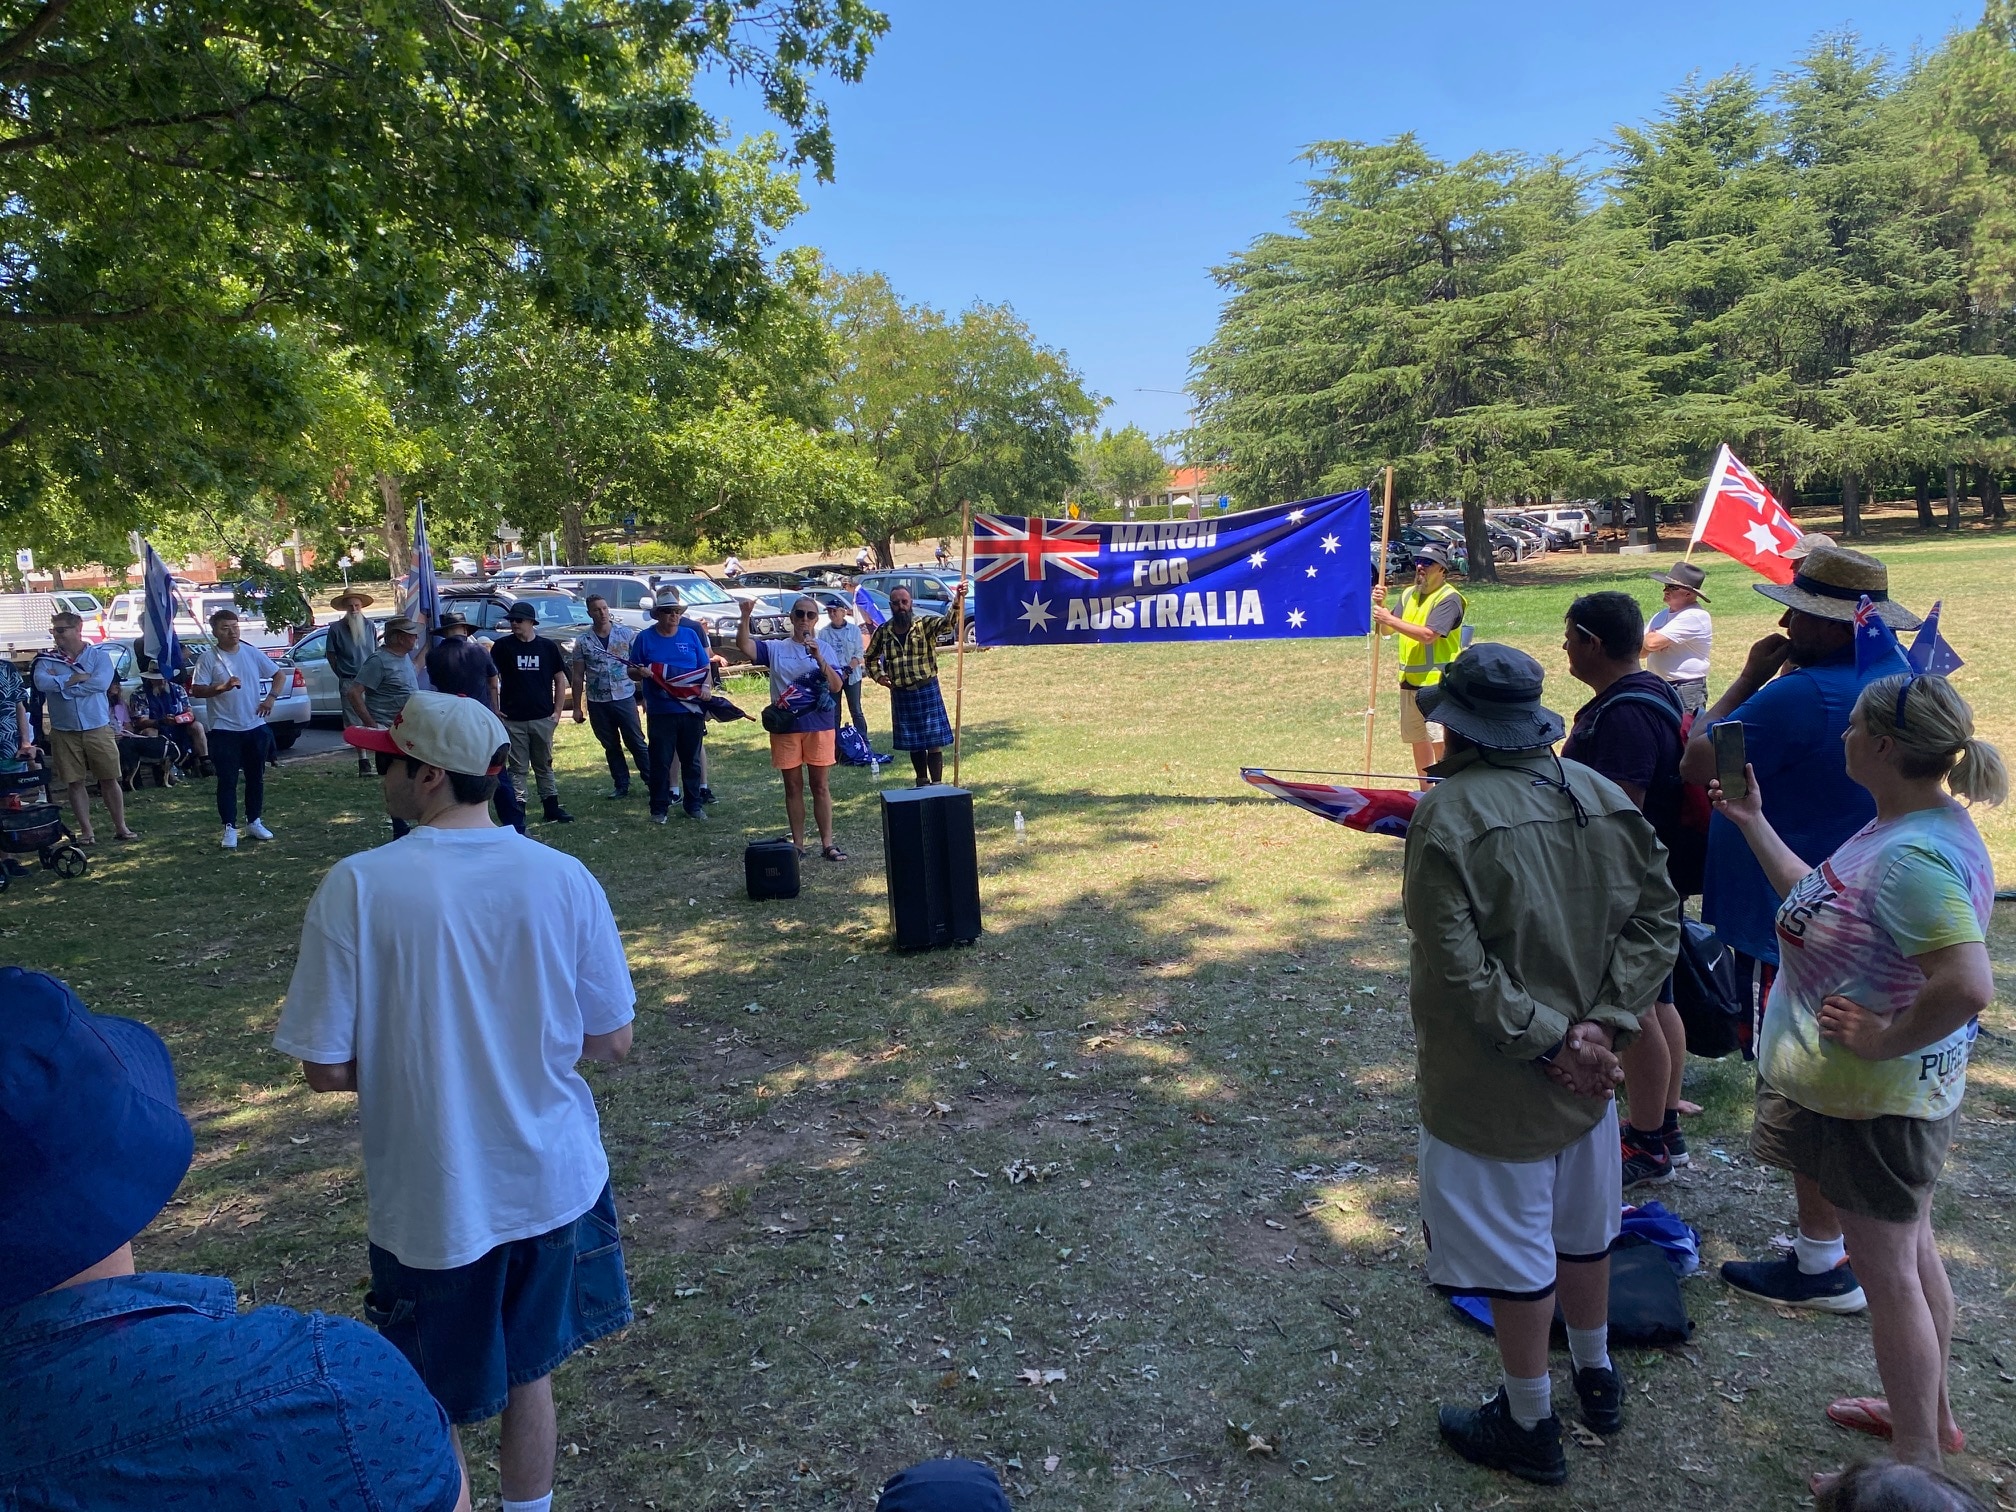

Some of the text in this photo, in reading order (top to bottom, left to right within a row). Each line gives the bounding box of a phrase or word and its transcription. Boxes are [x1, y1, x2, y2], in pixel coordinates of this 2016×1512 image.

[1110, 521, 1218, 552] MARCH
[1133, 557, 1190, 587] FOR
[1066, 589, 1264, 631] AUSTRALIA
[517, 655, 540, 667] HH
